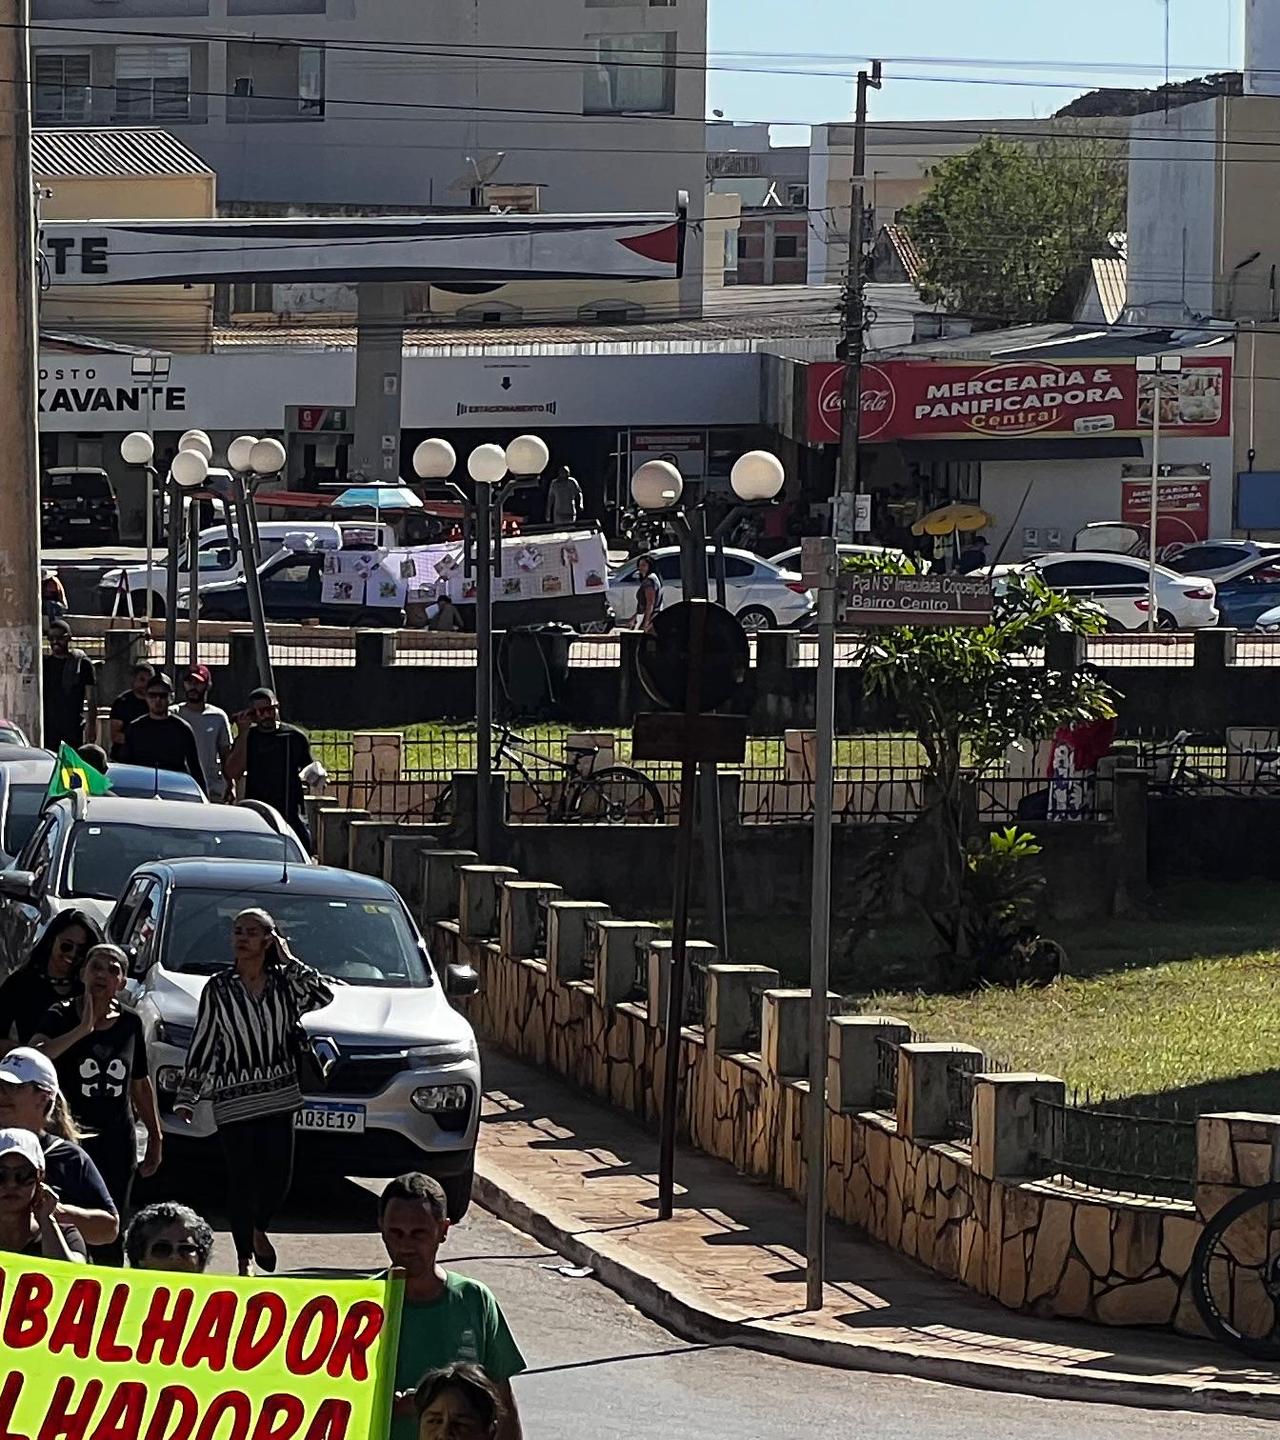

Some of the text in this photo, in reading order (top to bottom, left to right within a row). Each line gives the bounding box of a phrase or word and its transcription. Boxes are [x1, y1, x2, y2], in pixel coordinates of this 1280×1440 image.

[38, 368, 97, 380] OSTO
[927, 368, 1113, 399] MERCEARIA &
[915, 386, 1124, 420] PANIFICADORA
[971, 408, 1058, 427] Central
[895, 576, 940, 593] Imaculada
[942, 578, 990, 598] Conceição
[852, 594, 949, 611] Bairro Centro
[295, 1111, 356, 1129] AQ3E19
